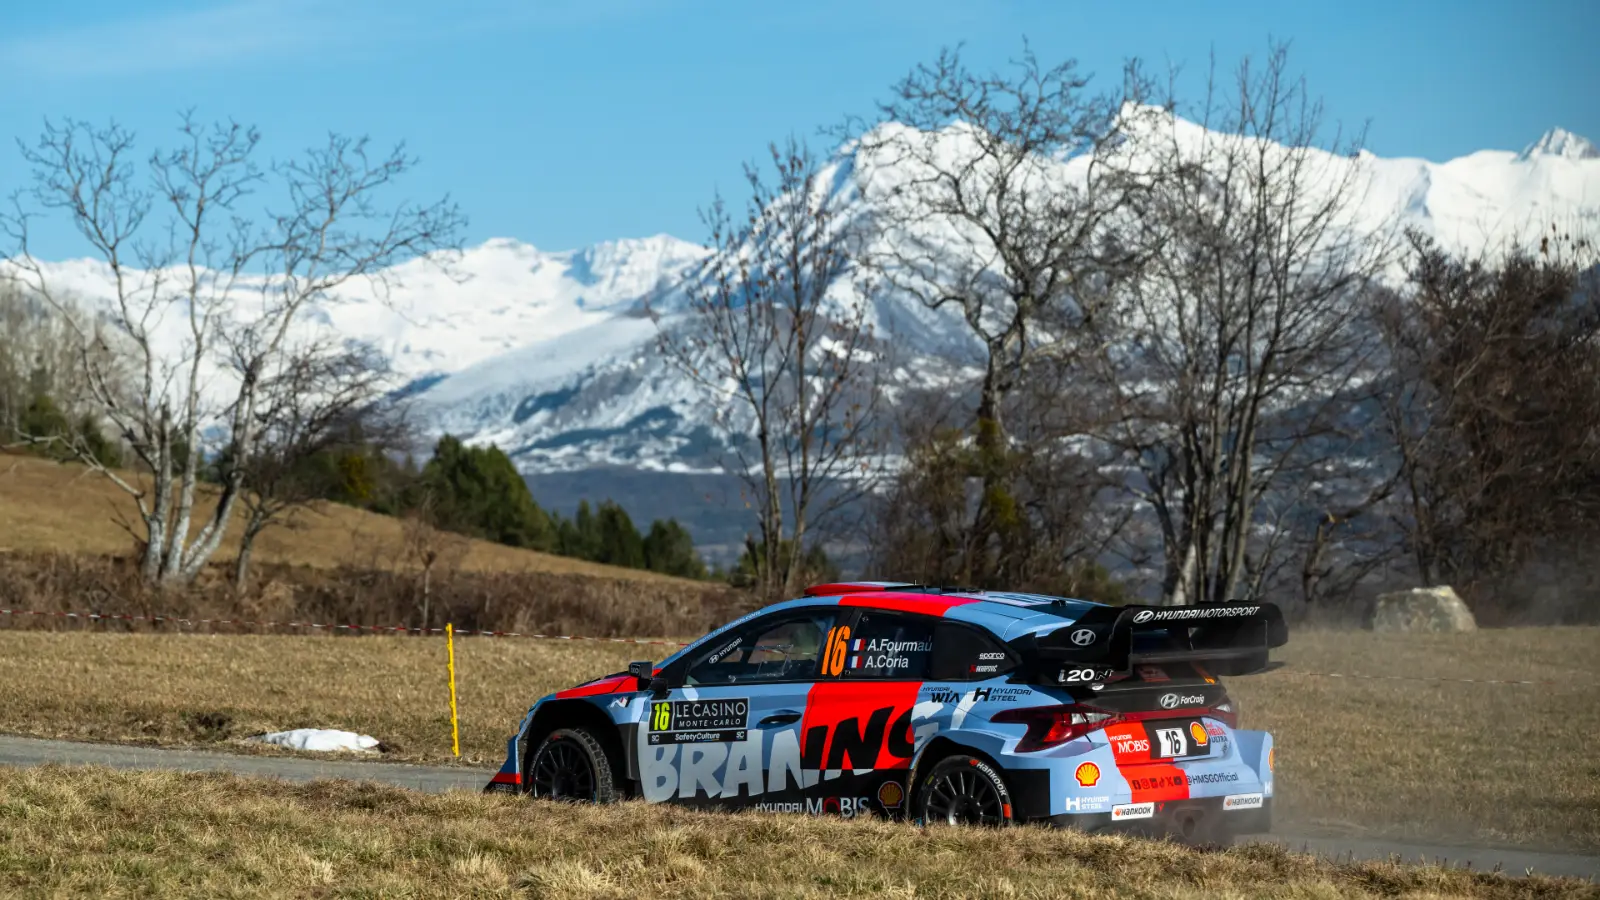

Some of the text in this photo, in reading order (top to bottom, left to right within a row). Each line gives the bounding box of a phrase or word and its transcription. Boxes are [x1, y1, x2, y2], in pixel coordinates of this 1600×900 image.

[719, 637, 742, 657] HYUNDAI
[821, 625, 851, 676] 16
[865, 655, 908, 668] A.Coria
[979, 652, 1005, 660] sparco
[992, 688, 1032, 696] HYUNDAI
[1180, 694, 1205, 705] ForCraig
[676, 701, 746, 718] LE CASINO
[653, 702, 671, 731] 16
[674, 732, 721, 742] SafetyCulture
[735, 731, 745, 739] SC
[1109, 734, 1132, 742] HYUNDAI
[1117, 739, 1150, 754] MOBIS
[1165, 730, 1181, 755] 16
[755, 802, 802, 814] HYUNDAI
